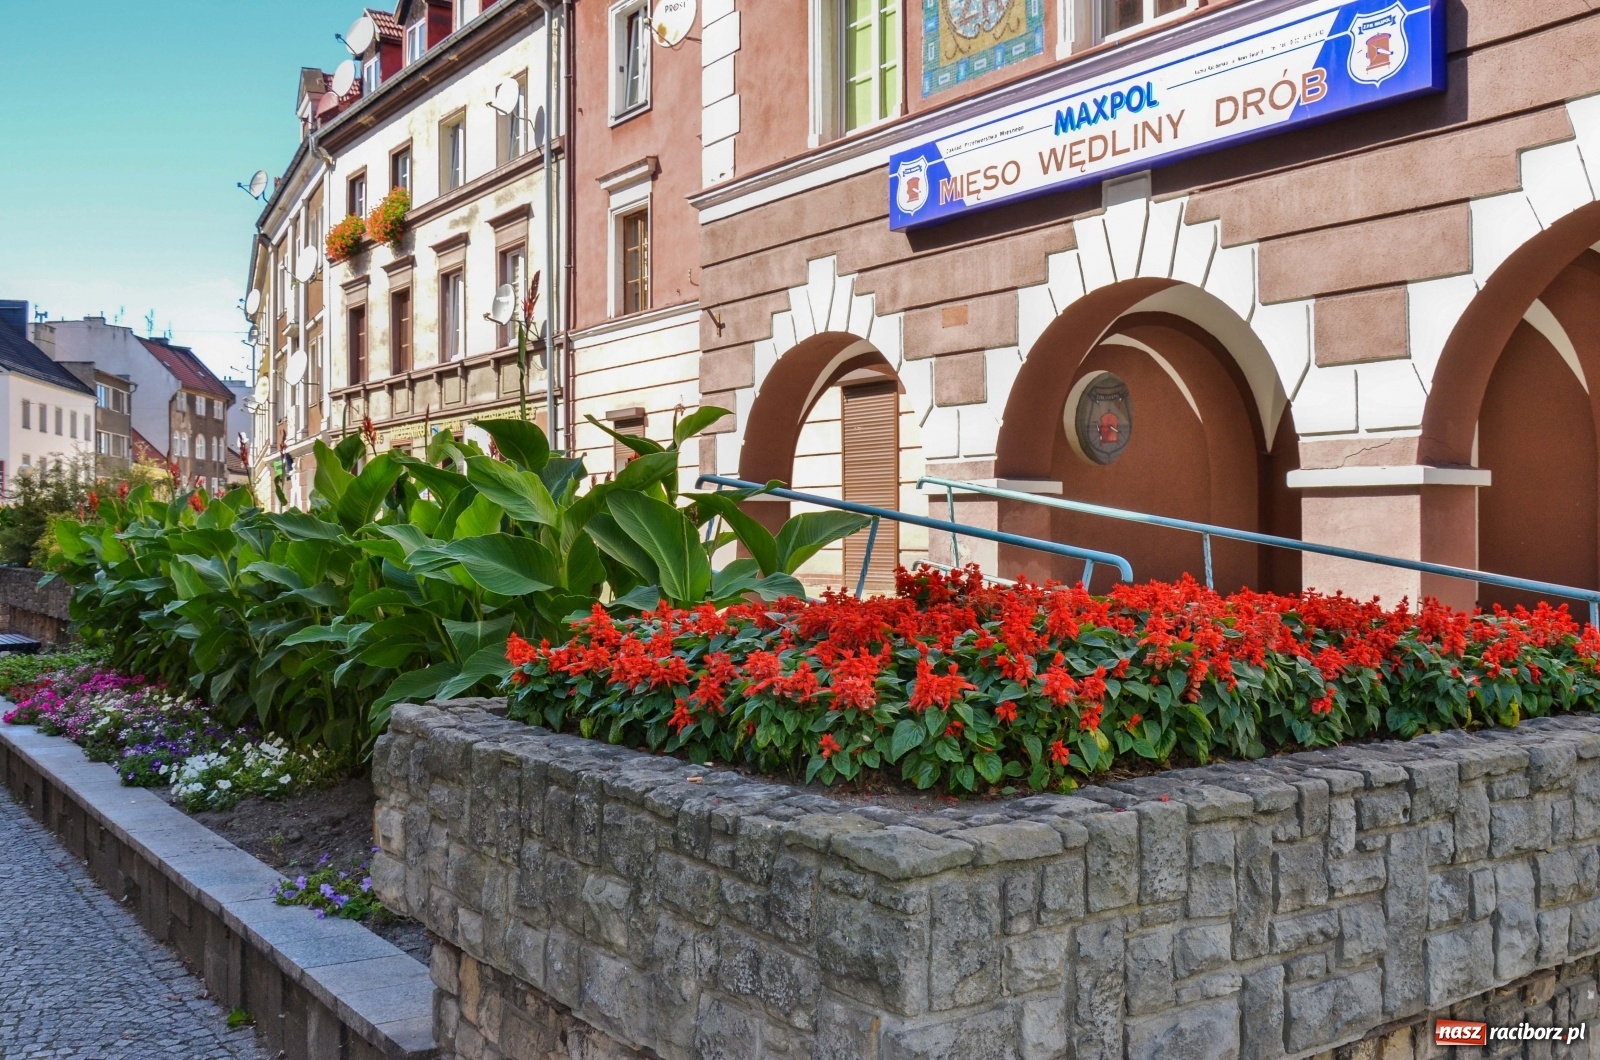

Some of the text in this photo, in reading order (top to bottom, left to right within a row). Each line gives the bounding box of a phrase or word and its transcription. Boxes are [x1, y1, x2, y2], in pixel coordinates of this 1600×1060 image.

[939, 67, 1328, 207] MIĘSO WĘDLINY DRÓB
[1054, 81, 1159, 136] MAXPOL
